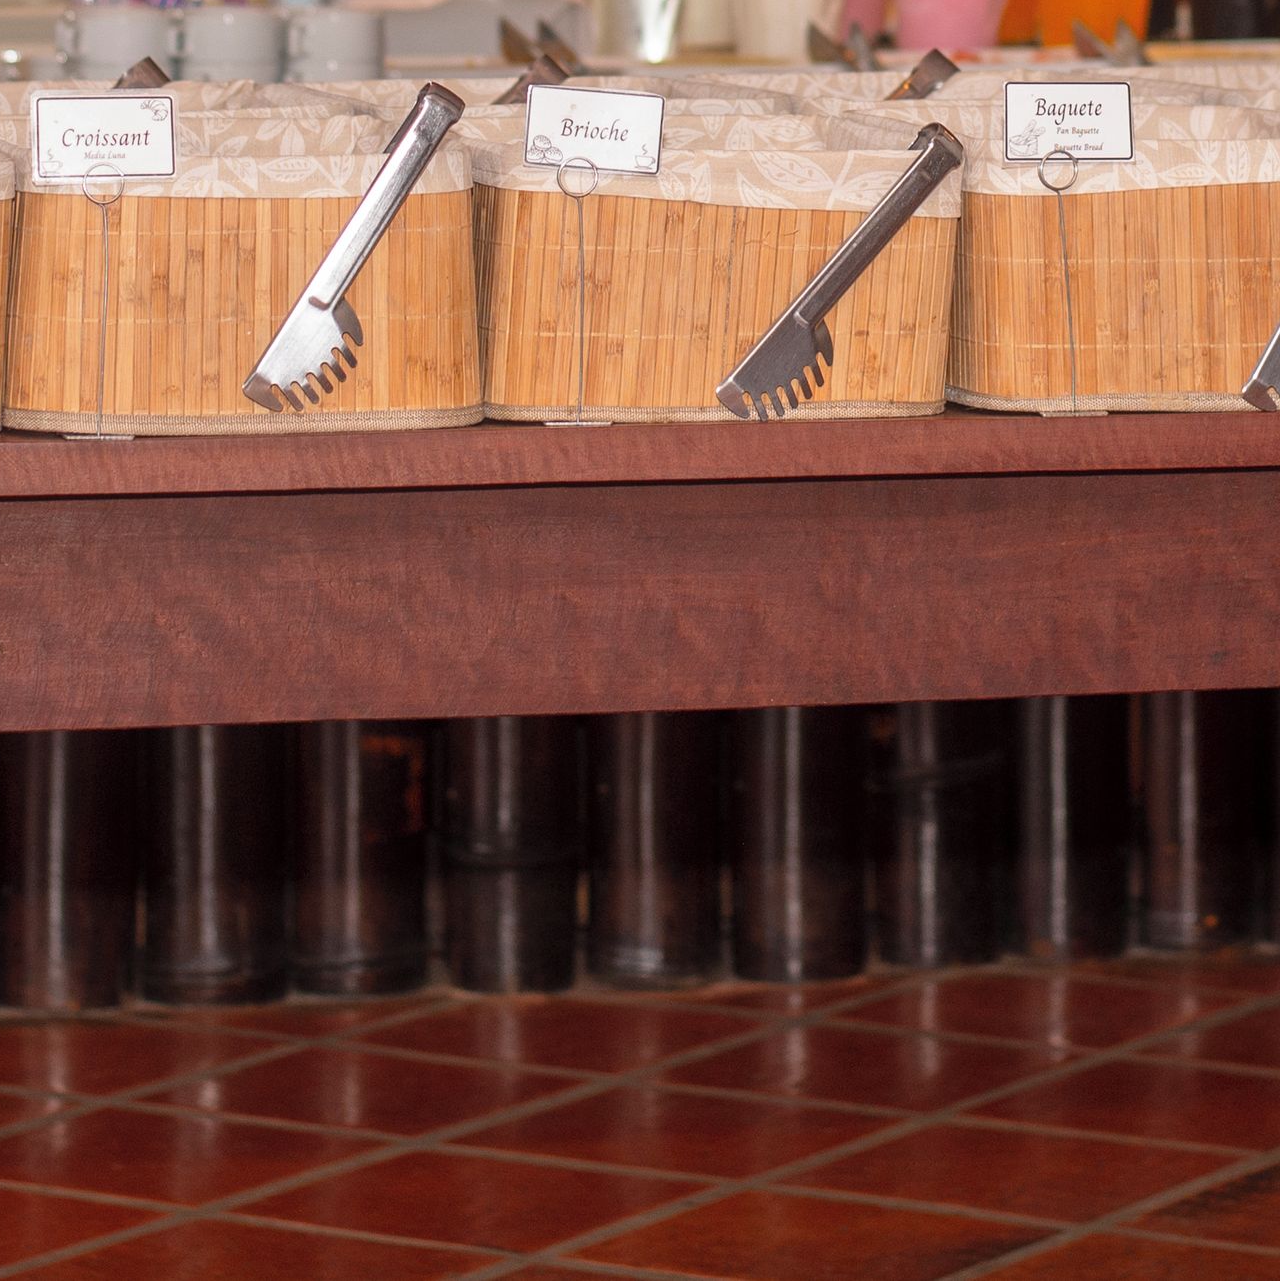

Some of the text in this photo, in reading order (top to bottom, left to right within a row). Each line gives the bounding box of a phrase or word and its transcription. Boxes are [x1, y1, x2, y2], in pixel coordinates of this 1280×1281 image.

[1034, 98, 1102, 125] Baguete
[62, 128, 151, 147] Croissant
[560, 118, 629, 141] Brioche
[1071, 127, 1100, 137] Baguette
[1083, 142, 1104, 151] Bread
